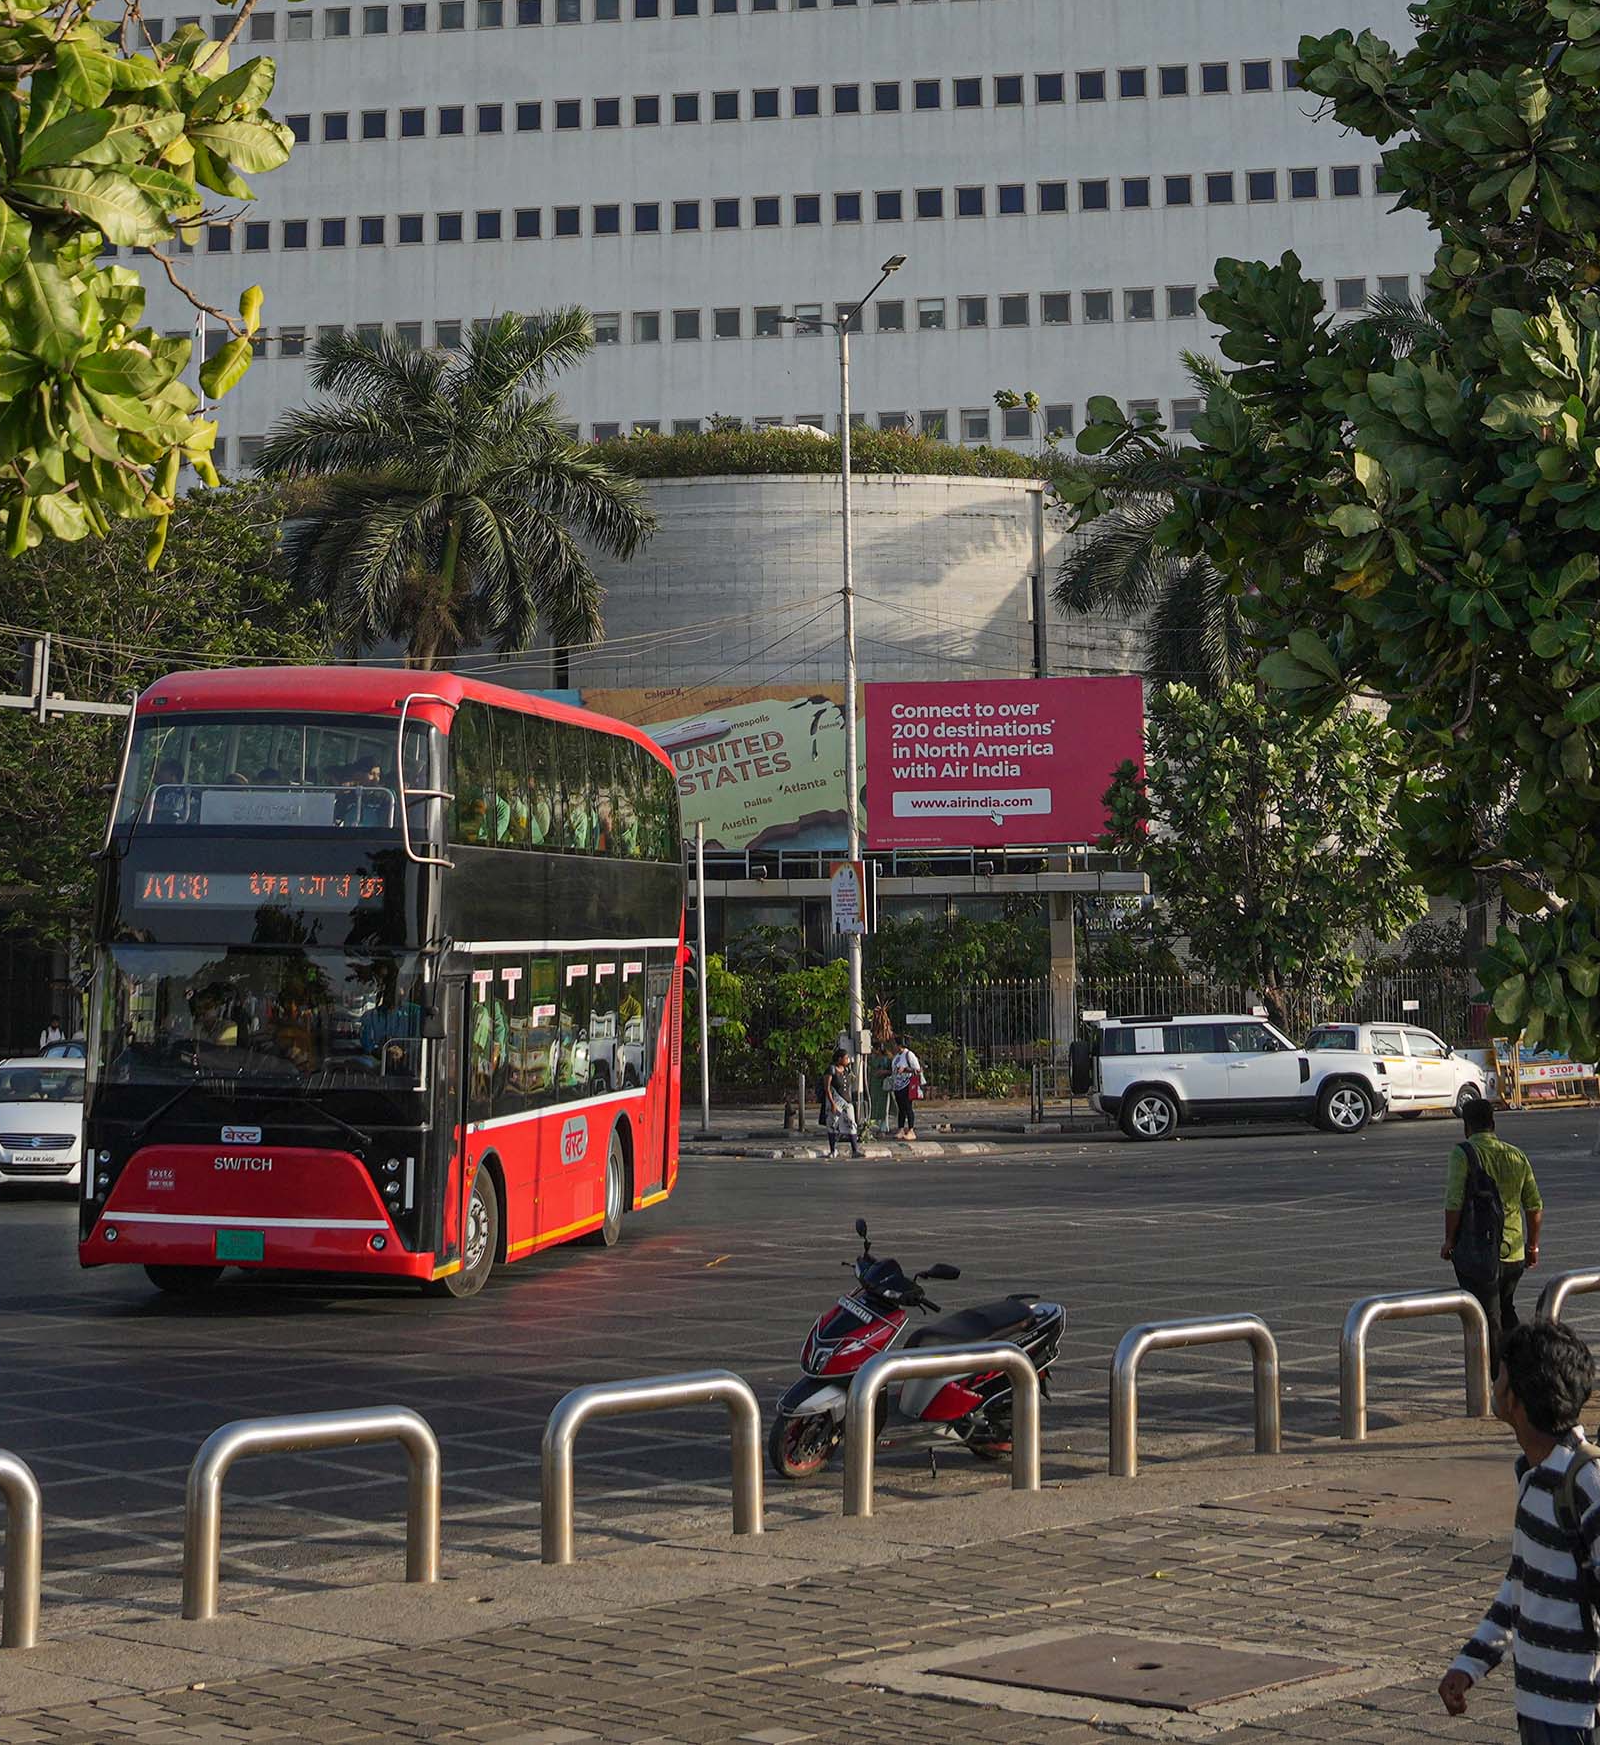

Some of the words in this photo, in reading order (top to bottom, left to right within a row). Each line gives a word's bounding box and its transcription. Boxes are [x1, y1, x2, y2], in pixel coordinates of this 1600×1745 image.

[891, 703, 970, 719] Connect
[975, 703, 994, 718] to
[998, 703, 1040, 717] over
[891, 723, 929, 739] 200
[674, 731, 784, 771] UNITED
[892, 743, 911, 758] in
[914, 742, 969, 758] North
[973, 740, 1054, 758] America
[678, 752, 792, 796] STATES
[892, 763, 937, 779] with
[940, 762, 968, 778] Air
[973, 762, 1021, 777] India
[783, 778, 827, 795] Atlanta
[743, 796, 773, 809] Dallas
[911, 796, 1033, 809] www.airindia.com
[721, 815, 758, 831] Austin
[1549, 1065, 1574, 1074] STOP
[224, 1127, 260, 1142] बेस्ट
[565, 1121, 584, 1161] बेस्ट
[214, 1158, 273, 1171] SWITCH
